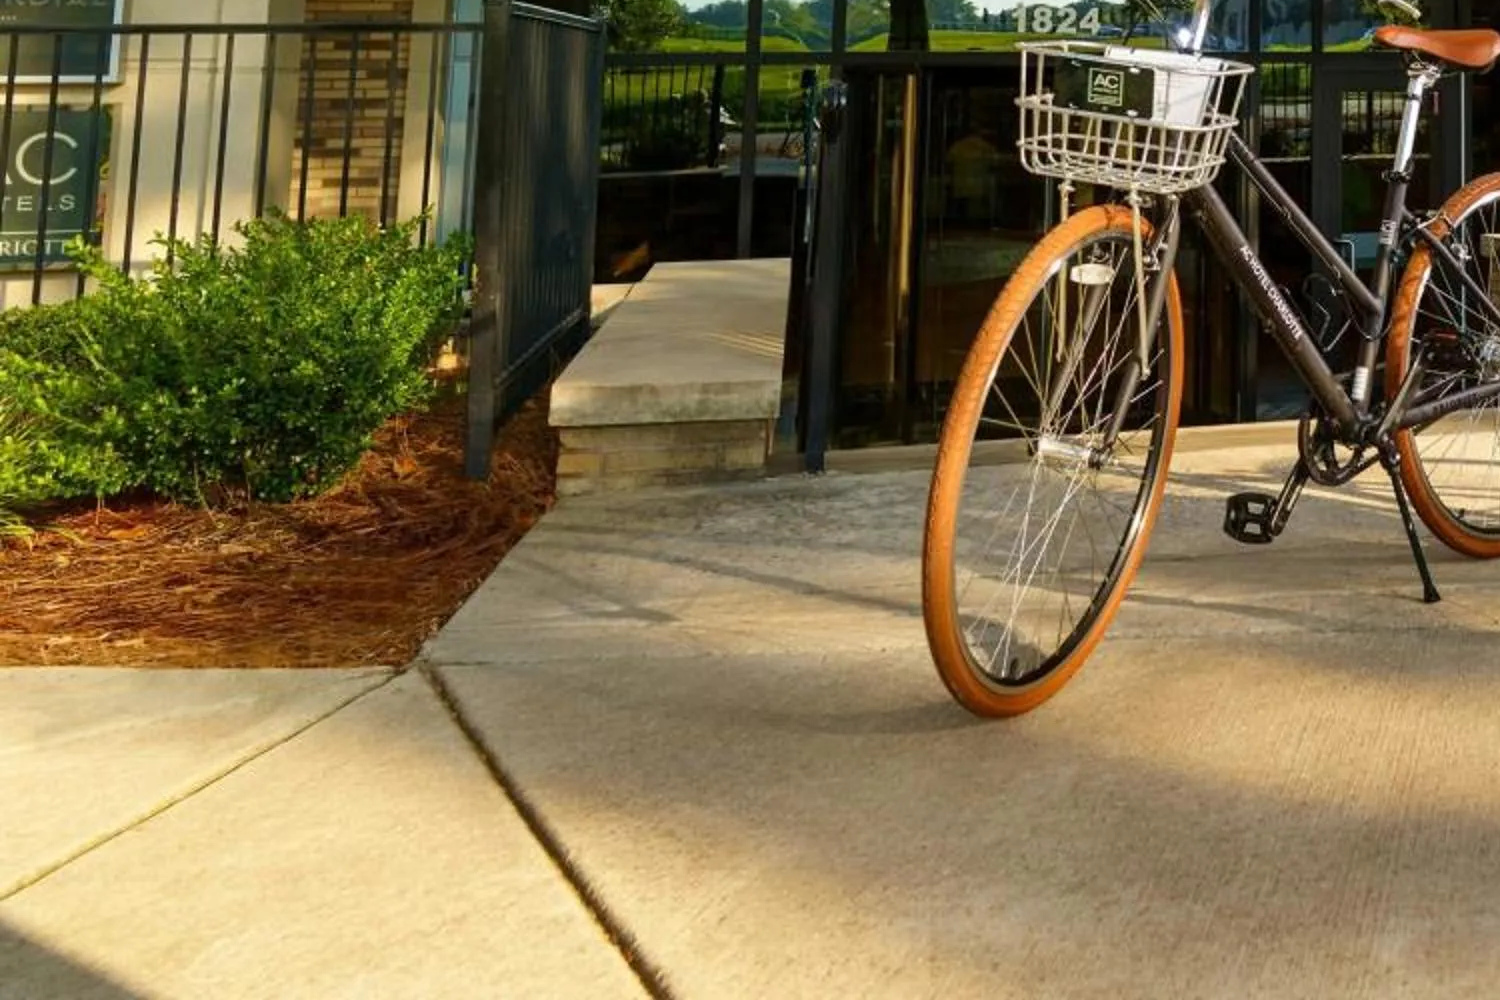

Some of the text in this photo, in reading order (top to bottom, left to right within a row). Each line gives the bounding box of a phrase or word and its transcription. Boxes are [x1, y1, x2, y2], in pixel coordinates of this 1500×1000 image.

[1012, 3, 1100, 36] 1824
[1094, 73, 1119, 89] AC
[5, 131, 78, 185] C
